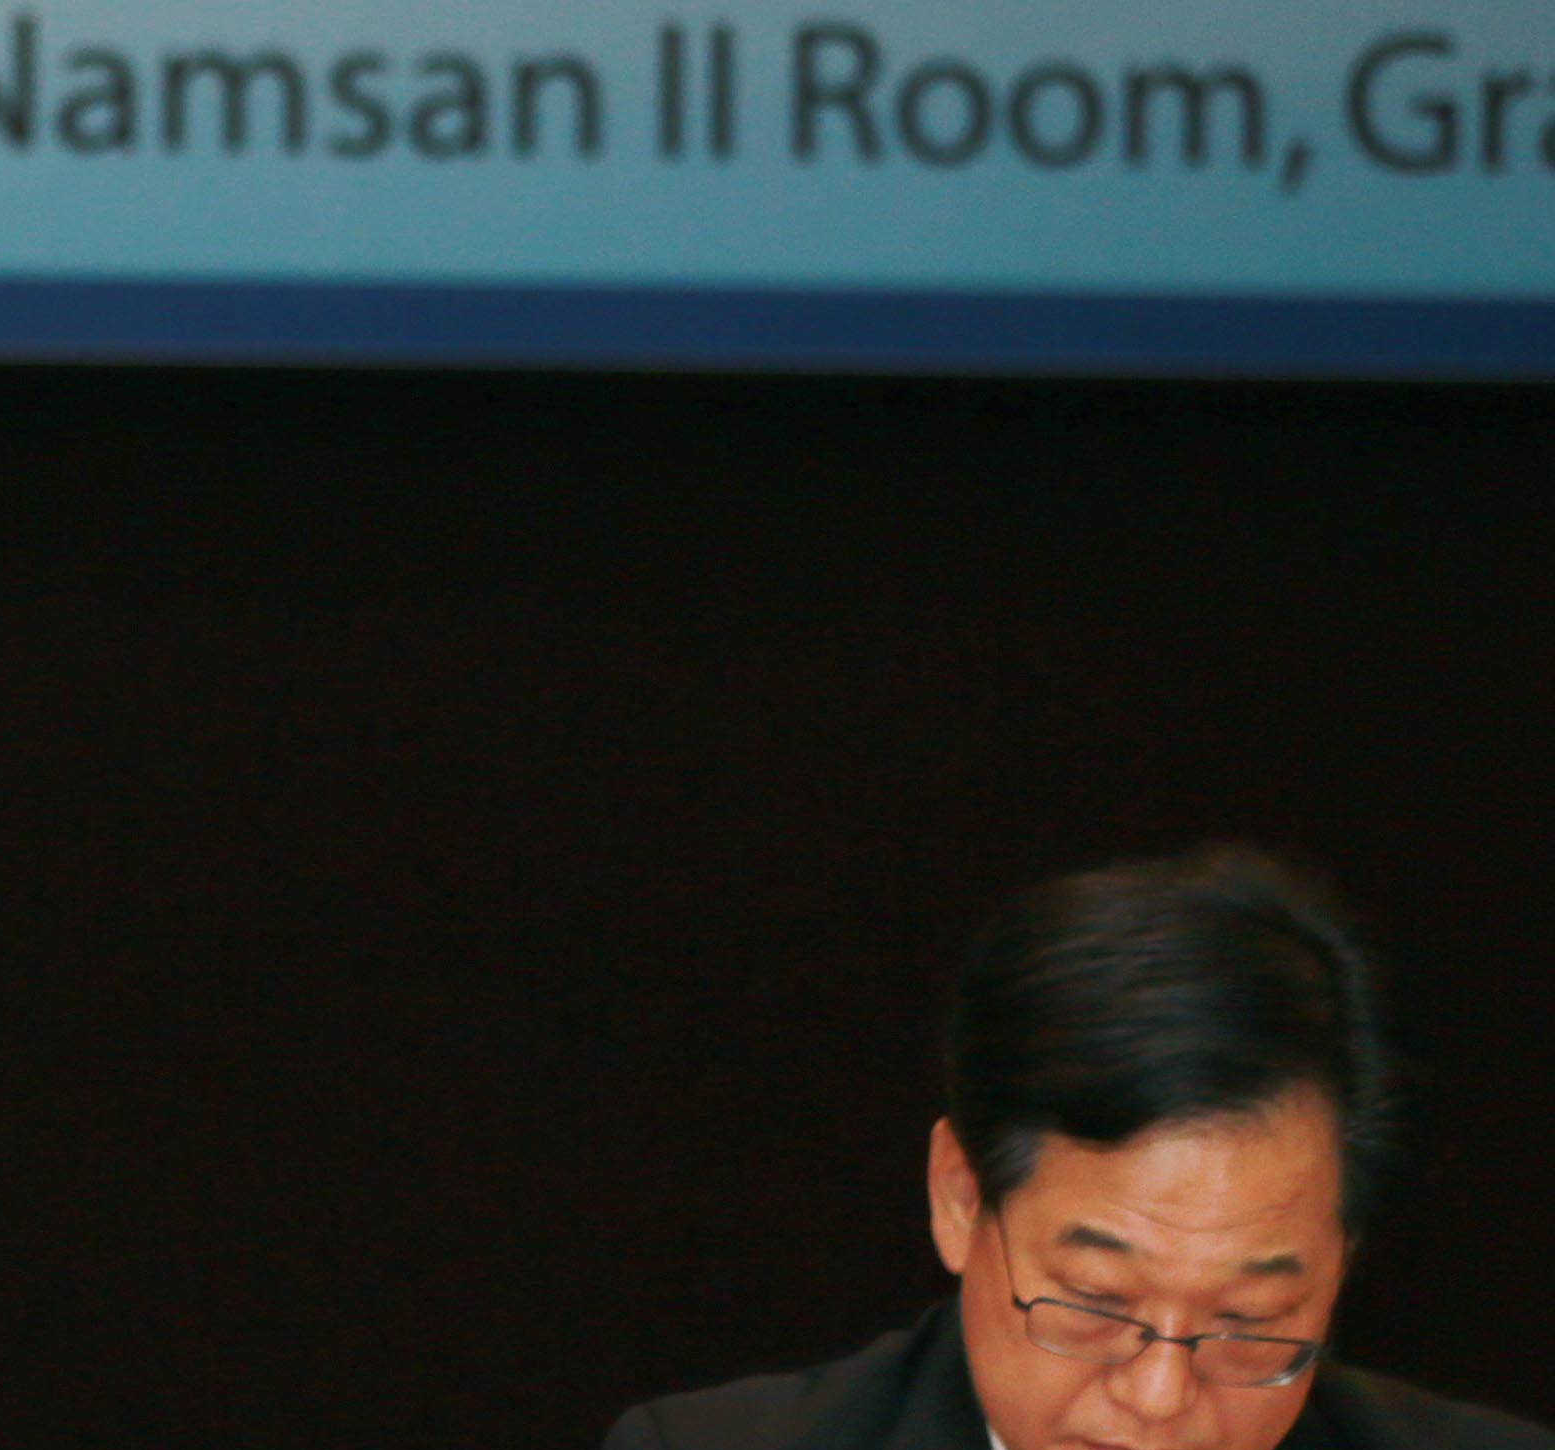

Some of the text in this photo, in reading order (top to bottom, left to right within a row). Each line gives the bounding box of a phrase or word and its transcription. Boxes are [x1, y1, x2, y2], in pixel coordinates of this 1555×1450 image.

[655, 24, 739, 162] II
[788, 23, 1318, 196] Room,
[1343, 30, 1555, 177] Gr
